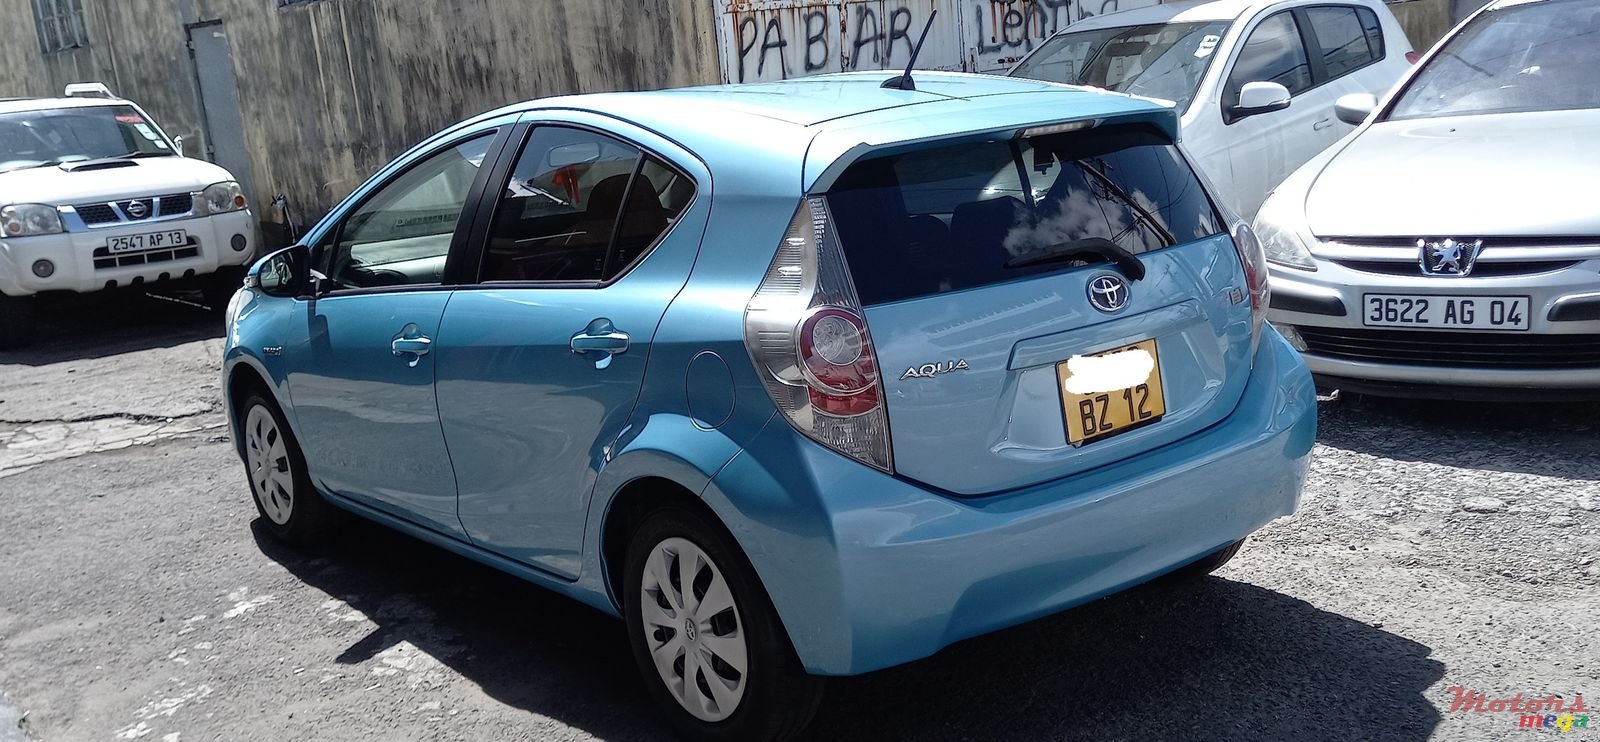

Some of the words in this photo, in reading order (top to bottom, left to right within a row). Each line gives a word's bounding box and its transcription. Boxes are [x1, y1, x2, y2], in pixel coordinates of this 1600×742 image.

[738, 15, 787, 84] PA
[112, 236, 143, 251] 2547
[149, 233, 163, 247] AP
[168, 231, 182, 245] 13
[1370, 297, 1429, 324] 3622
[1443, 299, 1474, 325] AG
[1490, 300, 1522, 326] 04
[898, 358, 970, 381] AQUA
[1079, 393, 1113, 436] BZ
[1122, 382, 1152, 422] 12
